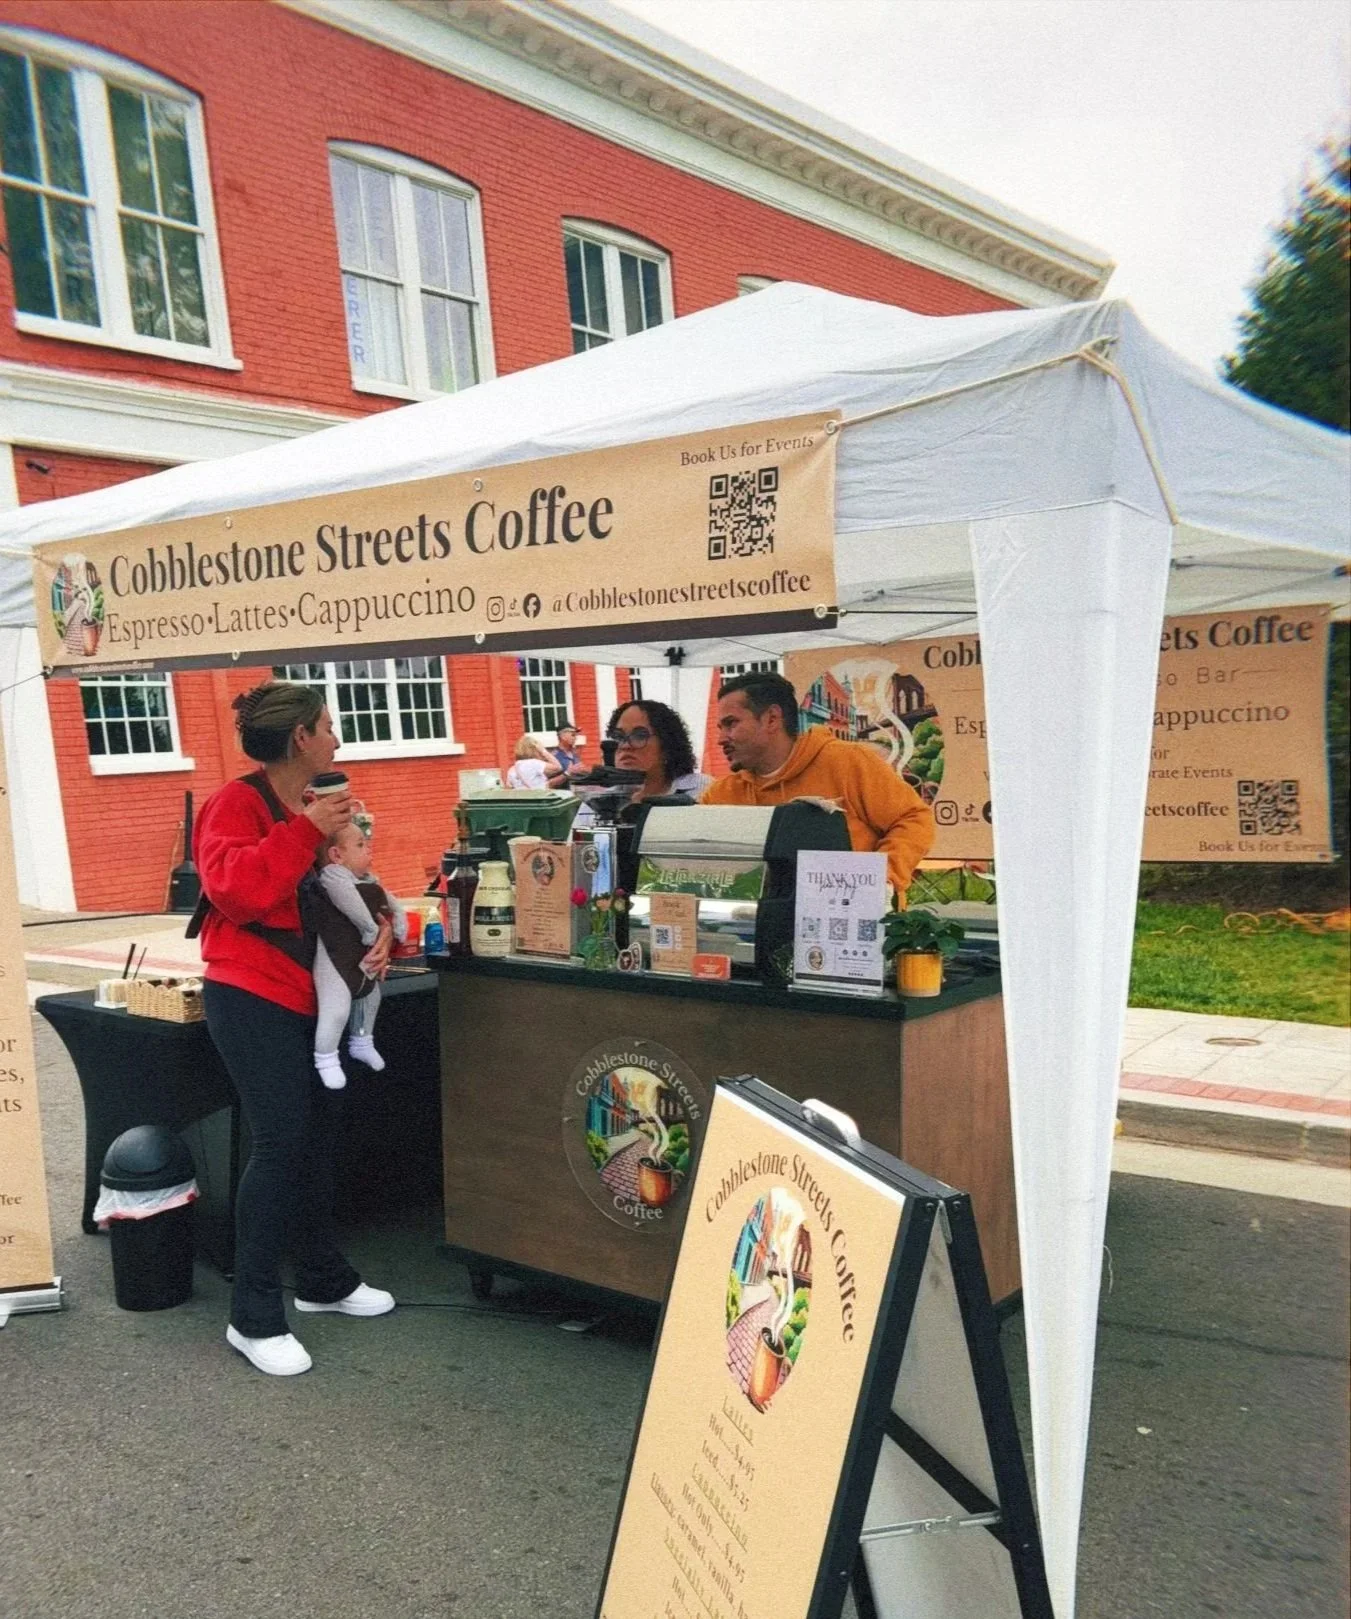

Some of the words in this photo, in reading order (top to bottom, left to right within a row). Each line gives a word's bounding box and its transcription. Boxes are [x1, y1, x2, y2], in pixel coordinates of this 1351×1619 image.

[681, 447, 716, 466] Book
[720, 444, 737, 460] Us
[740, 441, 762, 457] for
[766, 436, 814, 453] Events
[109, 539, 306, 598] Cobblestone
[316, 513, 452, 573] Streets
[464, 484, 614, 554] Coffee
[1208, 614, 1315, 648] Coffee
[1197, 666, 1241, 685] Bar
[1183, 765, 1234, 779] Events
[1198, 840, 1235, 852] Book
[1237, 840, 1257, 852] Us
[1260, 840, 1280, 852] for
[576, 1052, 658, 1096] Cobblestone
[659, 1062, 702, 1121] Streets
[612, 1194, 664, 1220] Coffee
[705, 1151, 788, 1224] Cobblestone
[789, 1153, 835, 1232] Streets
[829, 1228, 858, 1345] Coffee
